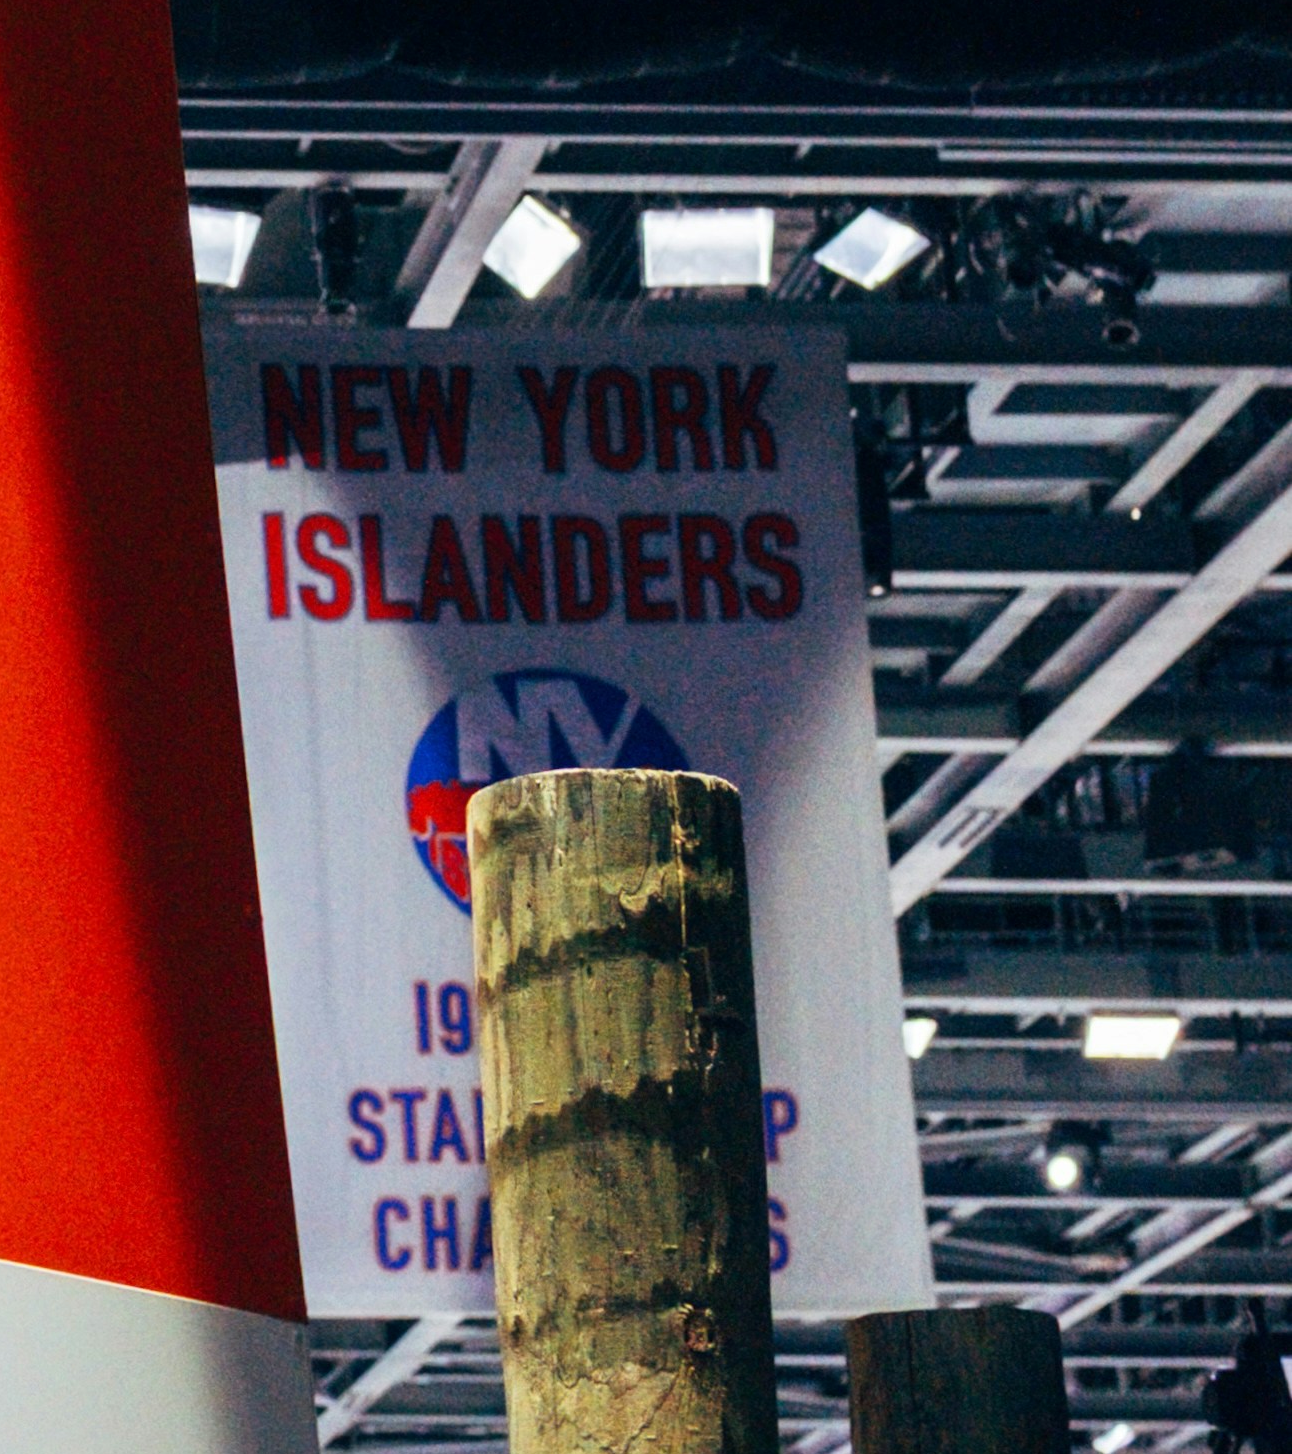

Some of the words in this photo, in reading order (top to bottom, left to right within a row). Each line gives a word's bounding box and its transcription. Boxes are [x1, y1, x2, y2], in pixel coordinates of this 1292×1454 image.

[261, 363, 472, 476] NEW
[517, 363, 779, 476] YORK
[261, 510, 804, 624] ISLANDERS
[414, 979, 475, 1055] 19
